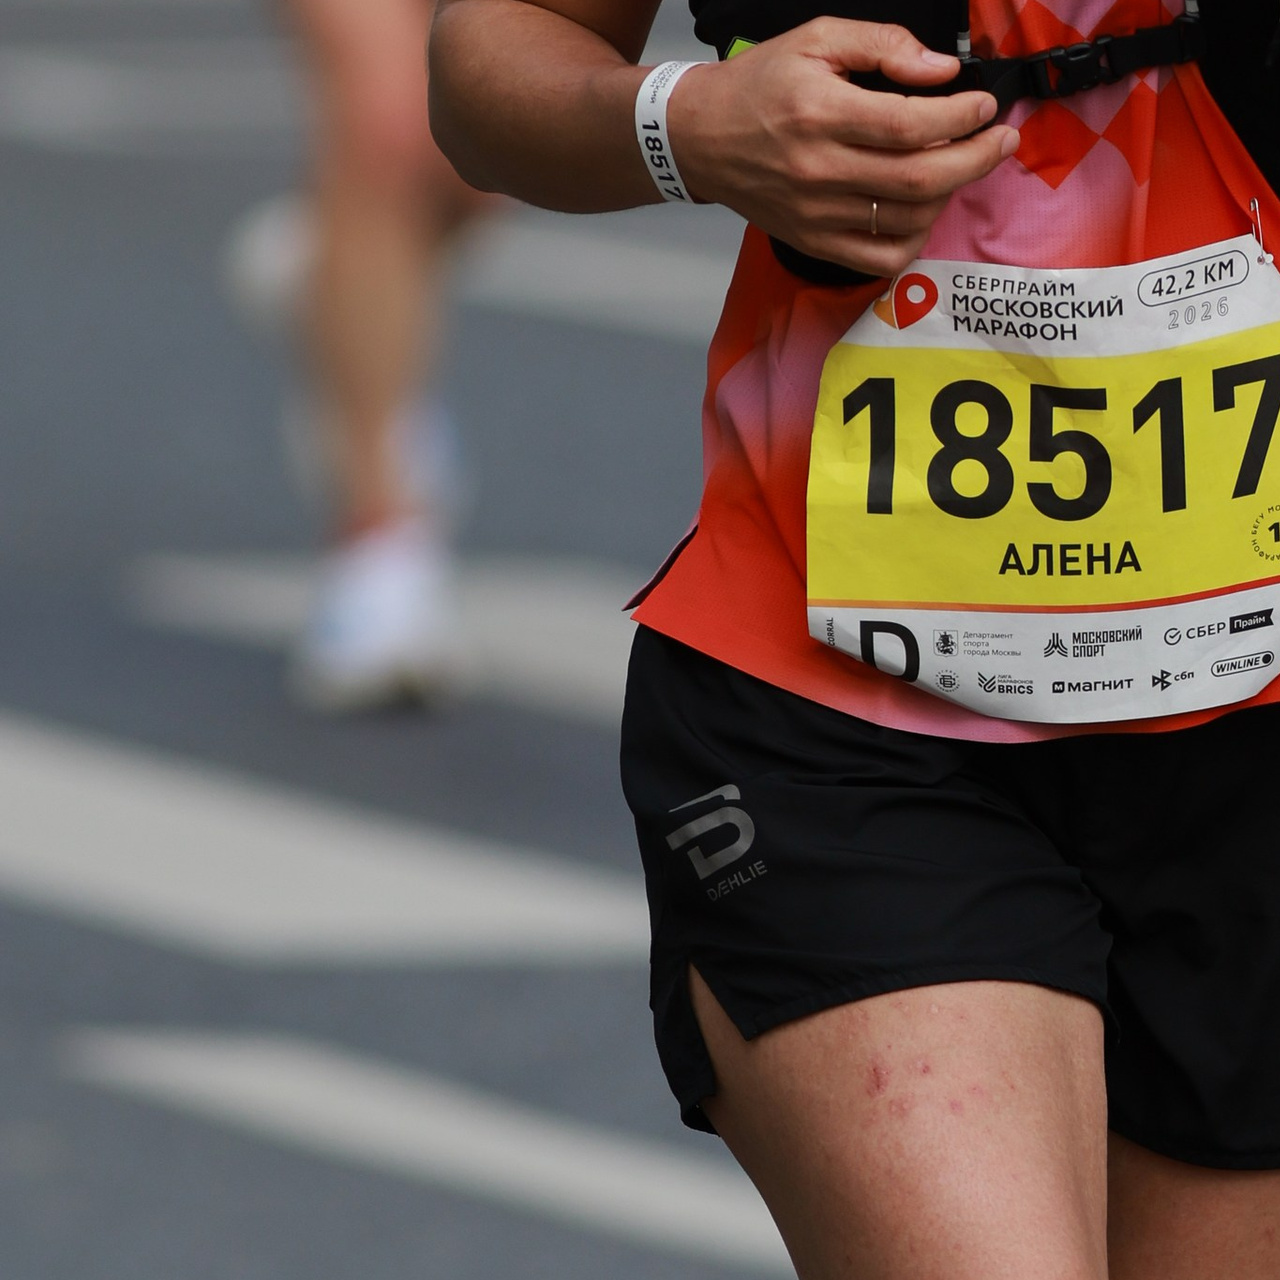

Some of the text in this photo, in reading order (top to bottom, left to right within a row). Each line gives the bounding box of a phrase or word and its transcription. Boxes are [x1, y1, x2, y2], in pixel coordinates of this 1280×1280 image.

[642, 120, 686, 201] 18517
[952, 274, 1076, 297] СБЕРПРАЙМ
[1151, 258, 1235, 297] 42,2 КМ
[951, 293, 1124, 320] МОСКОВСКИЙ
[1168, 296, 1229, 330] 2026
[952, 315, 1078, 341] МАРАФОН
[1251, 513, 1265, 535] БЕГУ
[1268, 521, 1280, 543] 1
[998, 540, 1143, 577] АЛЕНА
[962, 631, 1014, 640] Департамент
[1072, 624, 1143, 645] МОСКОВСКИЙ
[1185, 615, 1267, 640] СБЕР Прайм
[859, 620, 920, 683] D
[963, 640, 990, 648] спорта
[963, 649, 1022, 657] города Москвы
[1072, 644, 1106, 658] СПОРТ
[1173, 670, 1195, 682] сбп
[1215, 657, 1261, 674] WINLINE
[997, 684, 1034, 695] BRICS
